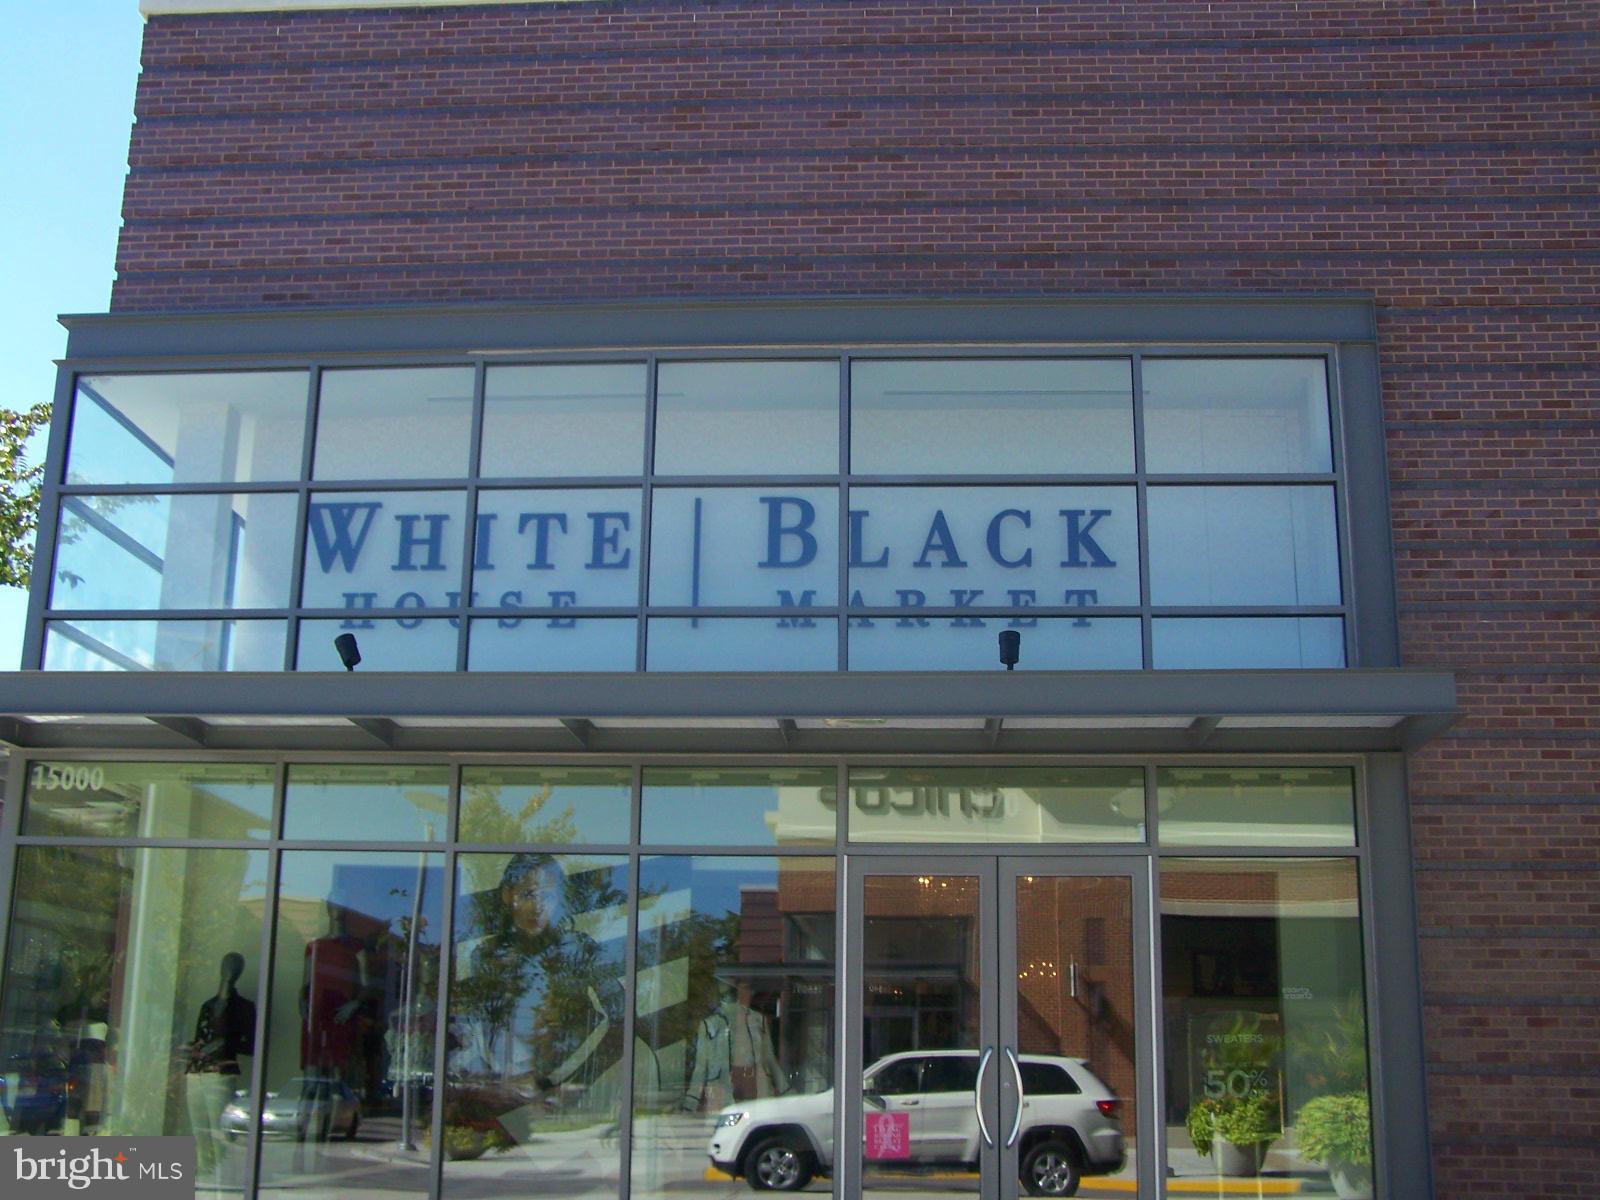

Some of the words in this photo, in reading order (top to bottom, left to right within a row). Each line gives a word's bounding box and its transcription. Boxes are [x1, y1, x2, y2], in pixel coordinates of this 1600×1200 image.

[308, 502, 631, 573] WHITE
[757, 497, 1117, 569] BLACK
[340, 591, 577, 629] HOUSE
[775, 589, 1099, 628] MARKET
[31, 765, 104, 791] 15000
[1206, 1033, 1264, 1044] SWEATERS
